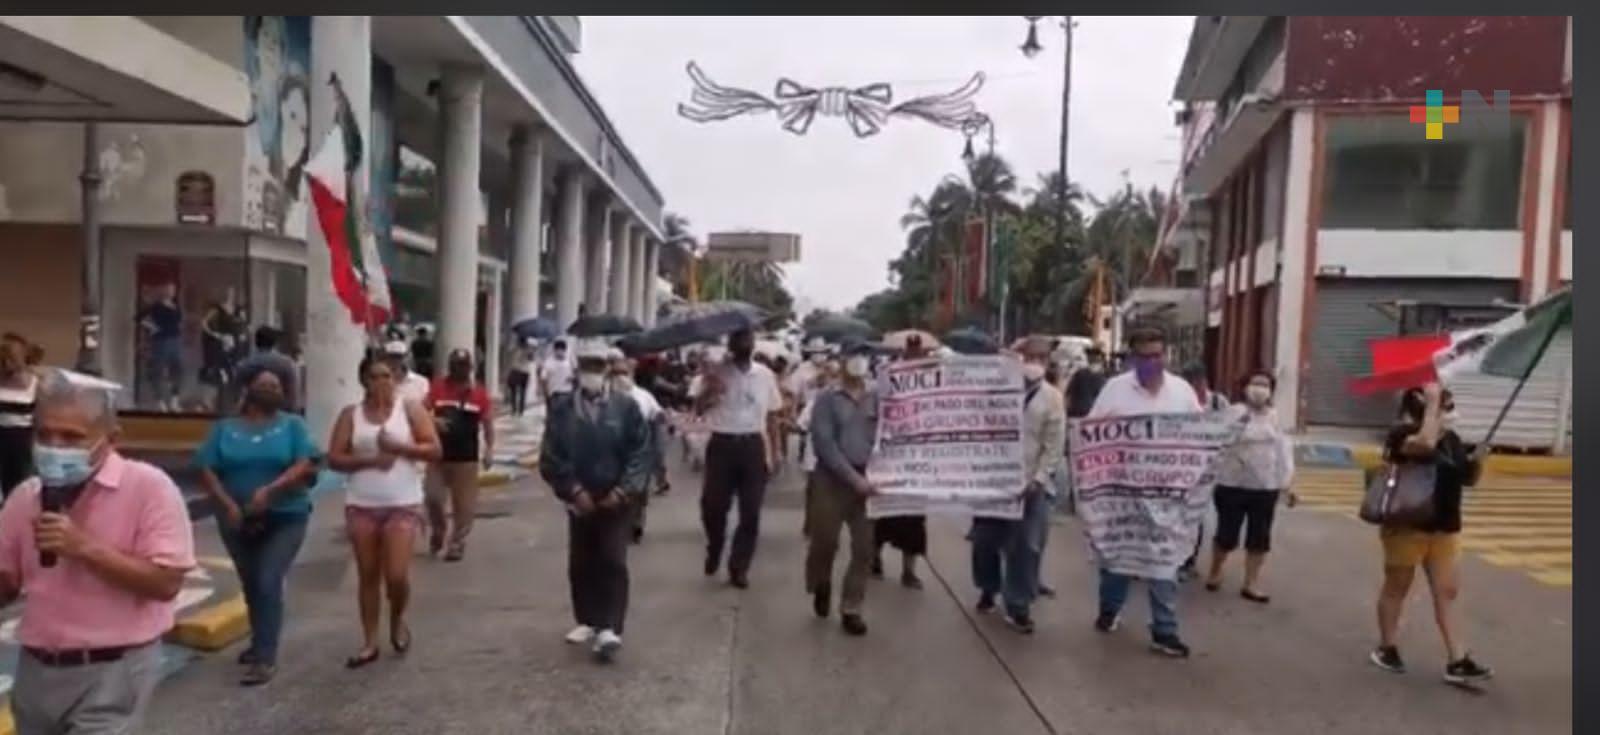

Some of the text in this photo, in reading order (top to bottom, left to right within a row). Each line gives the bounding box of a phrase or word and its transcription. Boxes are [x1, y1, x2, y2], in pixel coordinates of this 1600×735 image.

[889, 370, 942, 394] MOCI
[935, 399, 961, 410] PAGO
[964, 399, 985, 410] DEL
[987, 398, 1018, 410] AGUA
[923, 414, 980, 429] GRUPO
[1080, 419, 1154, 443] MOCI
[1144, 453, 1177, 466] PAGO
[1180, 453, 1202, 466] DEL
[1132, 470, 1196, 485] GRUPO
